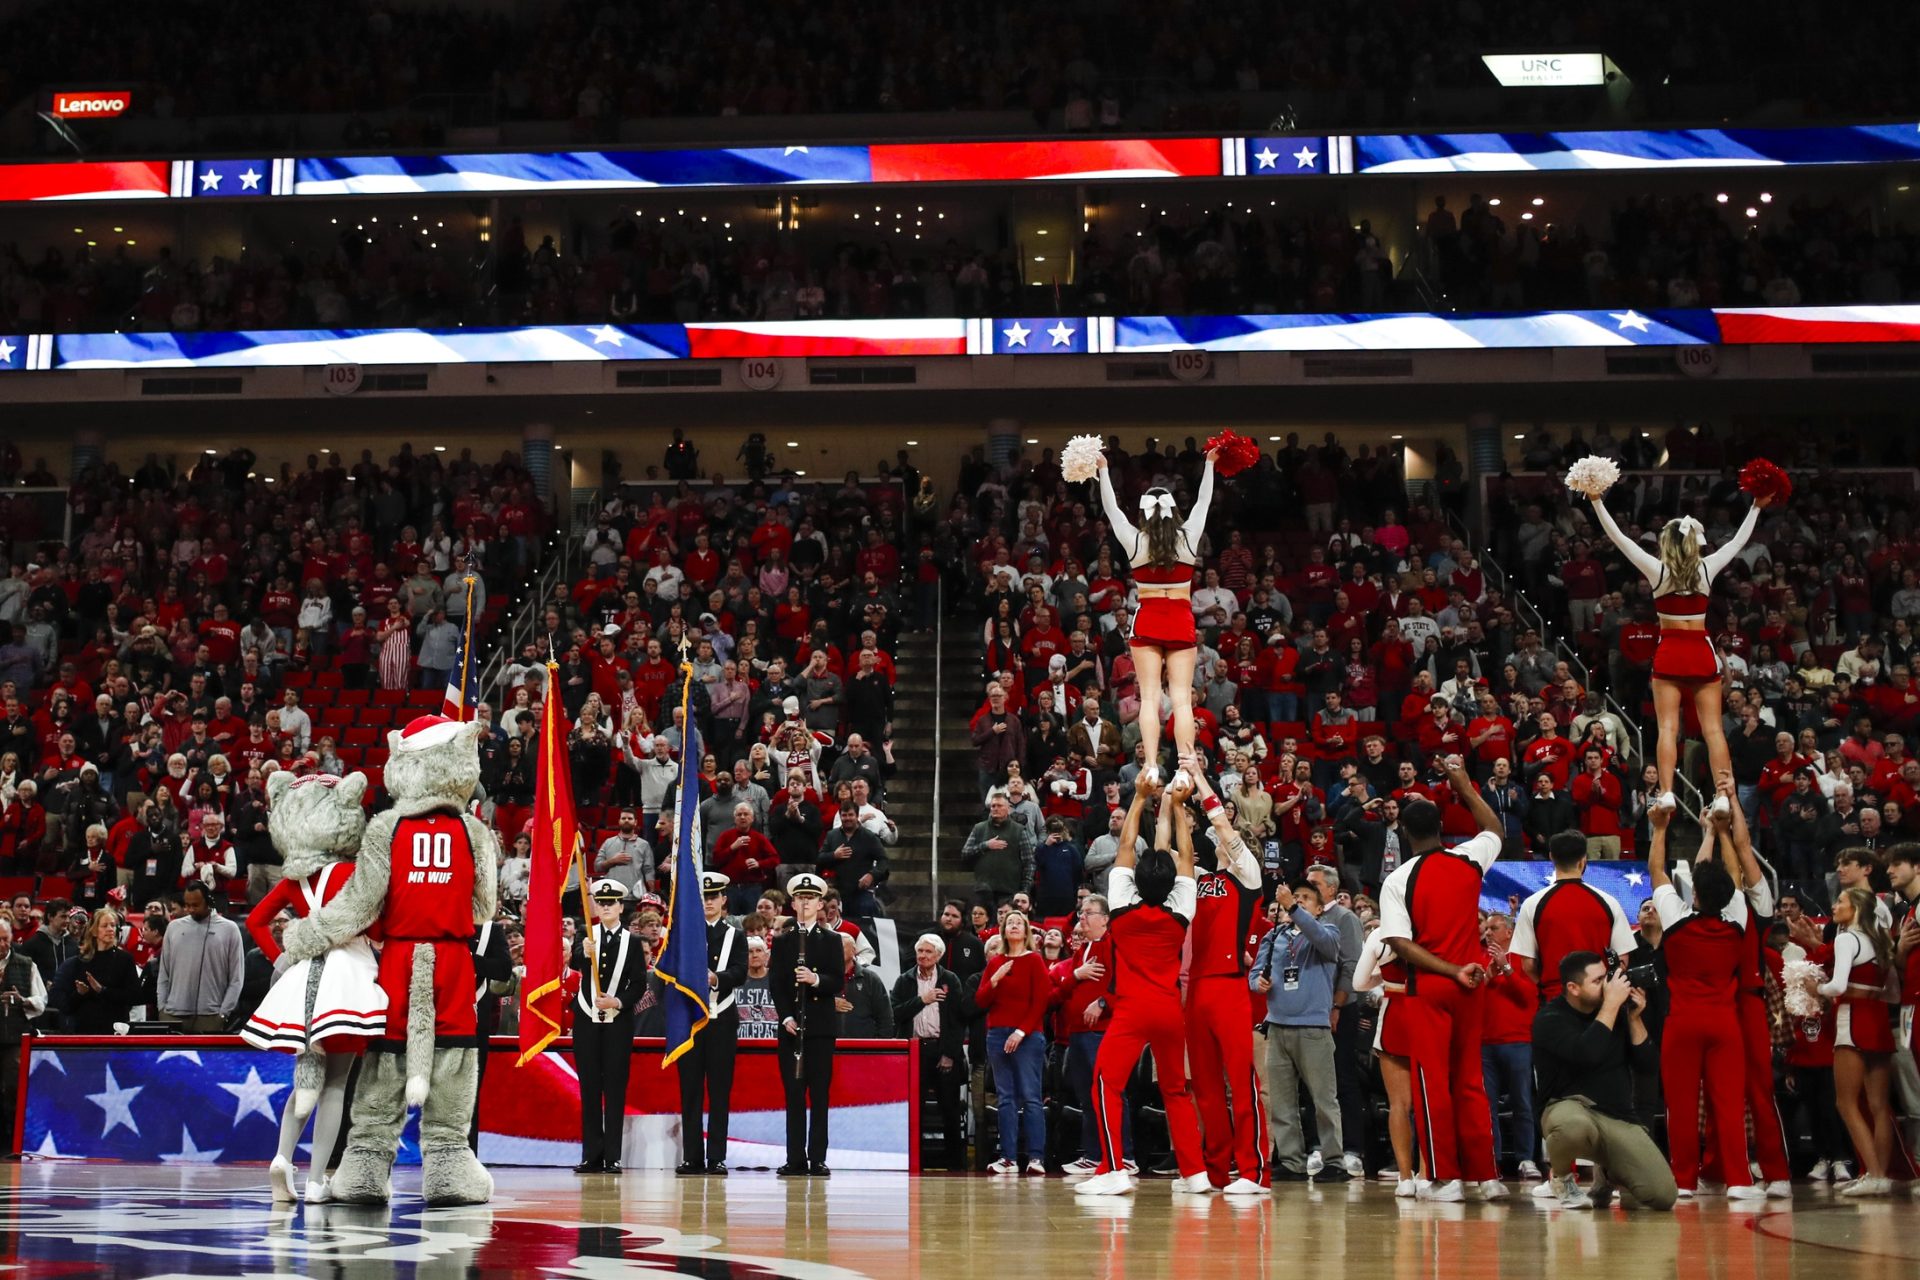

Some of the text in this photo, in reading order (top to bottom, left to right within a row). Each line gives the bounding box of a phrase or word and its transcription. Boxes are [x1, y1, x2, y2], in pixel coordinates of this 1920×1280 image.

[1521, 59, 1562, 73] UNC
[59, 98, 124, 113] Lenovo
[1176, 354, 1203, 370] 105
[1684, 349, 1712, 364] 106
[330, 367, 356, 383] 103
[748, 362, 775, 378] 104
[1411, 621, 1430, 631] STATE
[412, 832, 452, 868] 00
[407, 871, 453, 885] MR WUF
[747, 988, 775, 1005] STA
